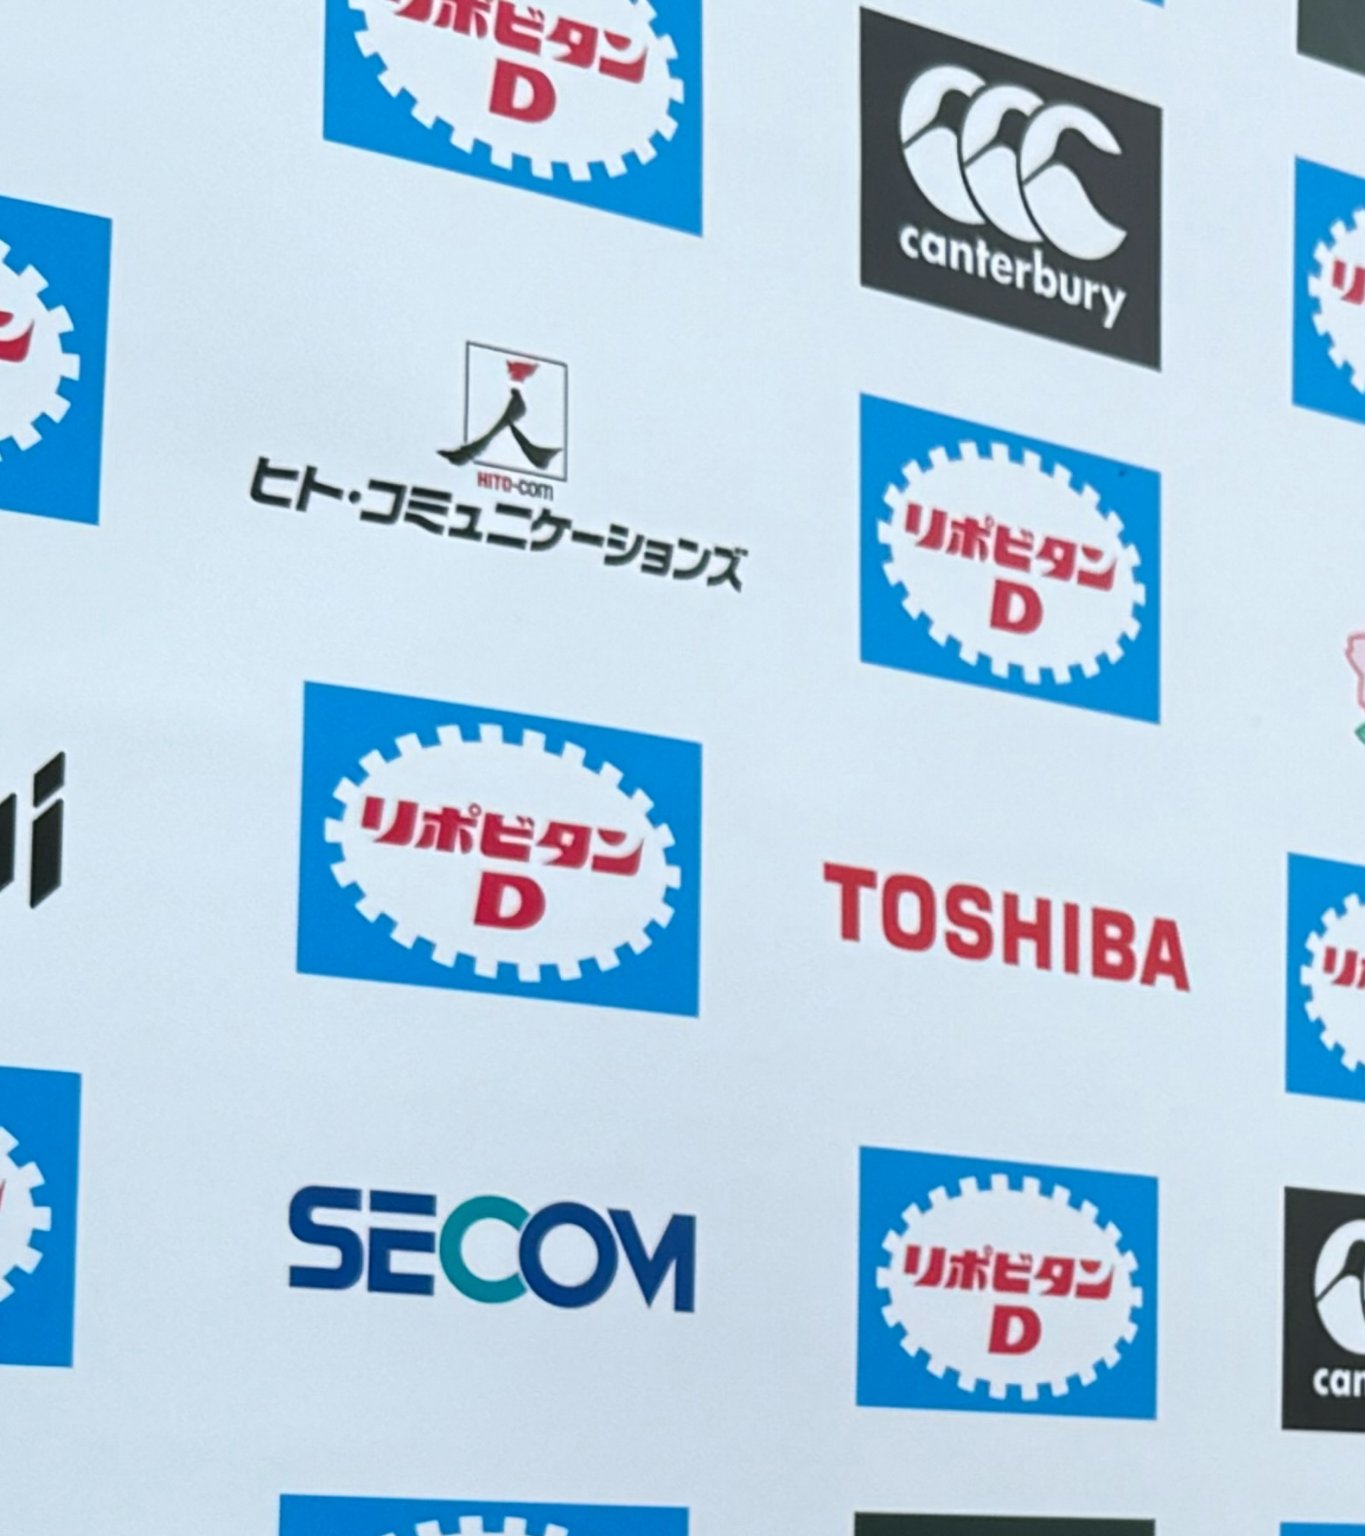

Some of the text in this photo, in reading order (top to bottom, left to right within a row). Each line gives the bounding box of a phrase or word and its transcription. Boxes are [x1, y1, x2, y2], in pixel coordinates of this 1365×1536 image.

[488, 57, 558, 123] D
[898, 220, 1129, 330] canterbury
[249, 456, 748, 594] ヒト・コミュニケーションズ
[903, 501, 1119, 592] リポビタン
[988, 576, 1043, 636] D
[359, 795, 645, 878] リポビタン
[472, 869, 547, 932] D
[821, 861, 1191, 992] TOSHIBA
[287, 1183, 700, 1316] SECOM
[902, 1242, 1117, 1302] リポビタン
[987, 1303, 1042, 1356] D
